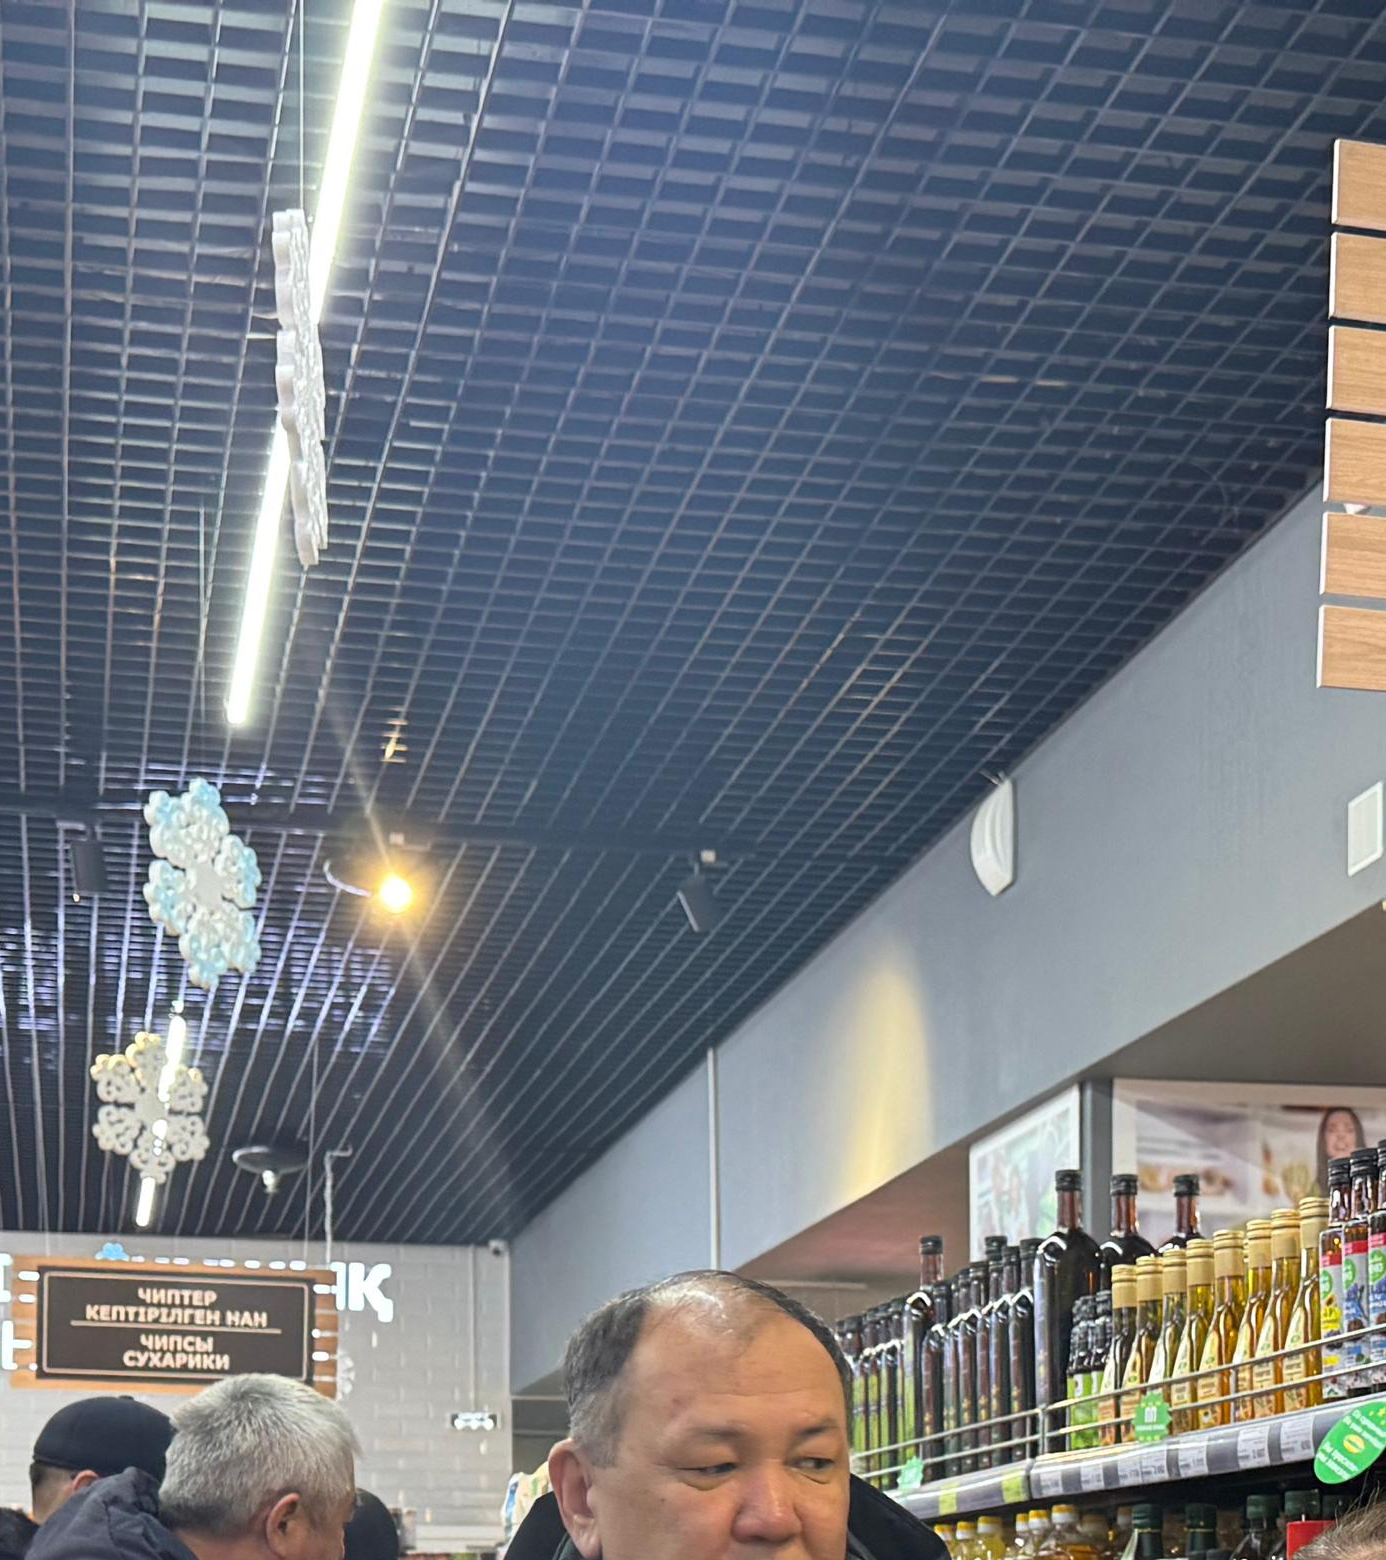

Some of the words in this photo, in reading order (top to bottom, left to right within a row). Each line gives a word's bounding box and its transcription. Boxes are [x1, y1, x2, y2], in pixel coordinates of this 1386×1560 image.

[137, 1287, 217, 1307] ЧИПТЕР
[85, 1304, 221, 1325] КЕПТІРІЛГЕН
[226, 1311, 268, 1329] НАН
[139, 1333, 214, 1353] ЧИПСЫ
[122, 1350, 230, 1370] СУХАРИКИ
